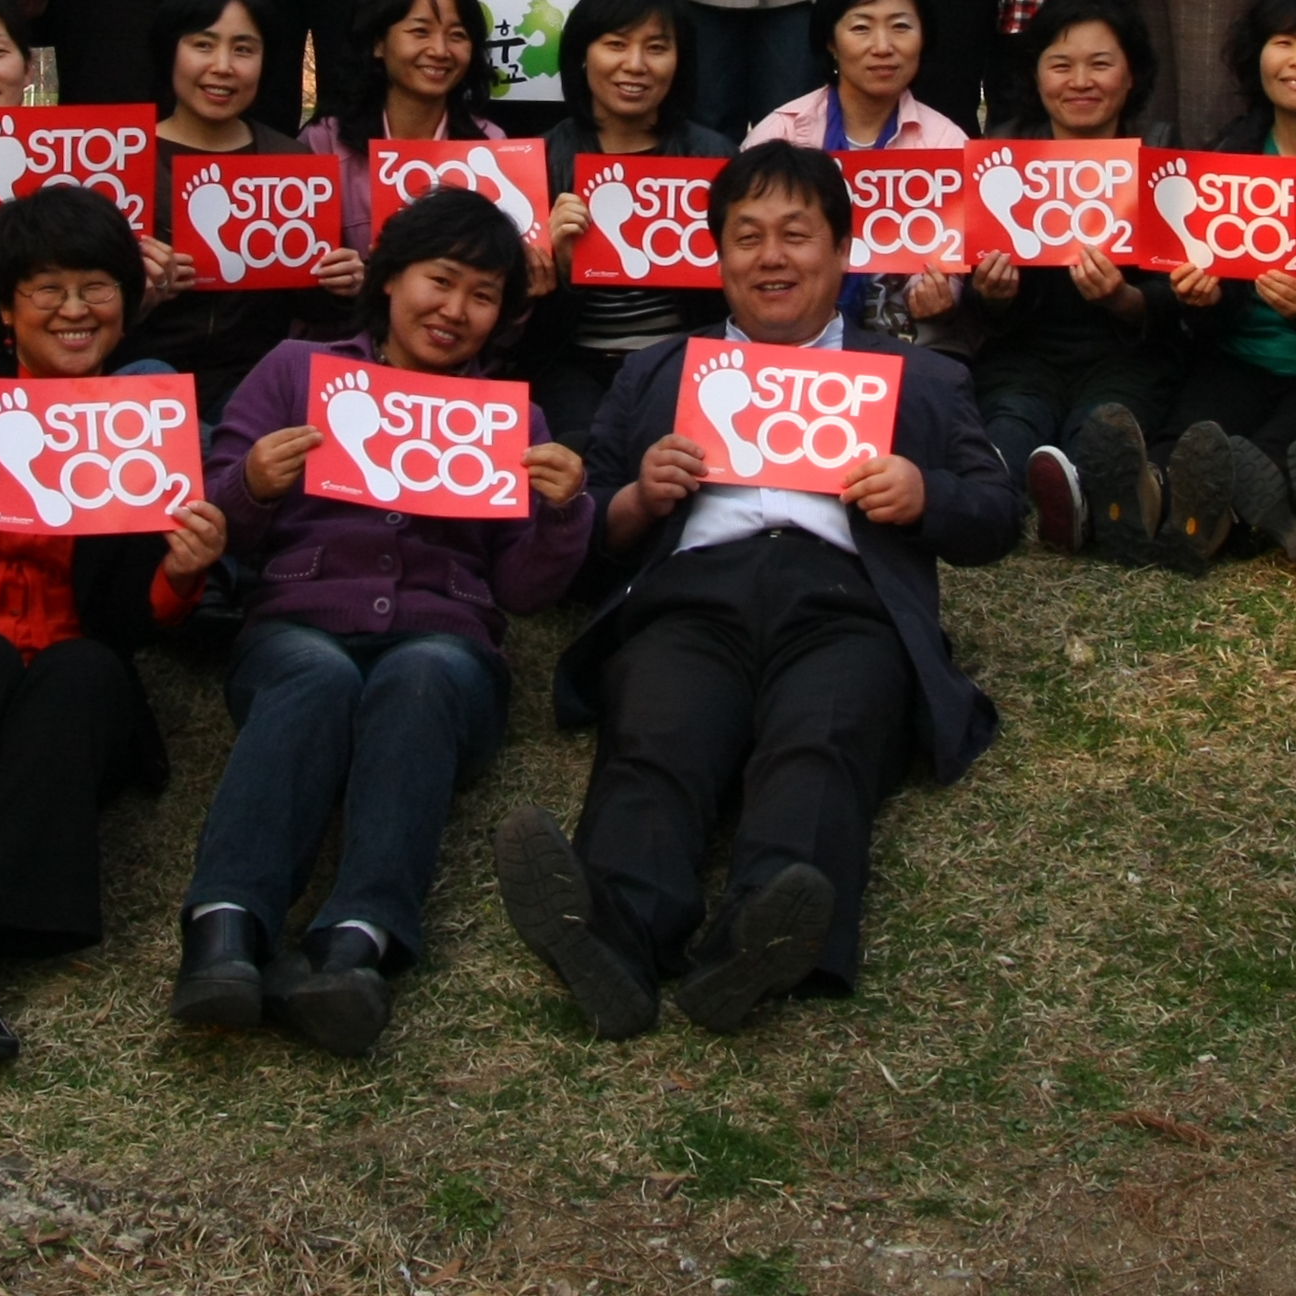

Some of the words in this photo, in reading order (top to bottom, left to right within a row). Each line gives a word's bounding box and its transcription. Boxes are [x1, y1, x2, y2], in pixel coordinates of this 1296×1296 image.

[486, 19, 527, 64] 후
[25, 127, 146, 174] STOP
[230, 177, 332, 219] STOP
[634, 177, 709, 220] STO
[850, 168, 962, 208] STOP
[1023, 159, 1132, 201] STOP
[643, 218, 720, 267] CO
[751, 366, 886, 416] STOP
[43, 398, 185, 453] STOP
[379, 392, 518, 446] STOP
